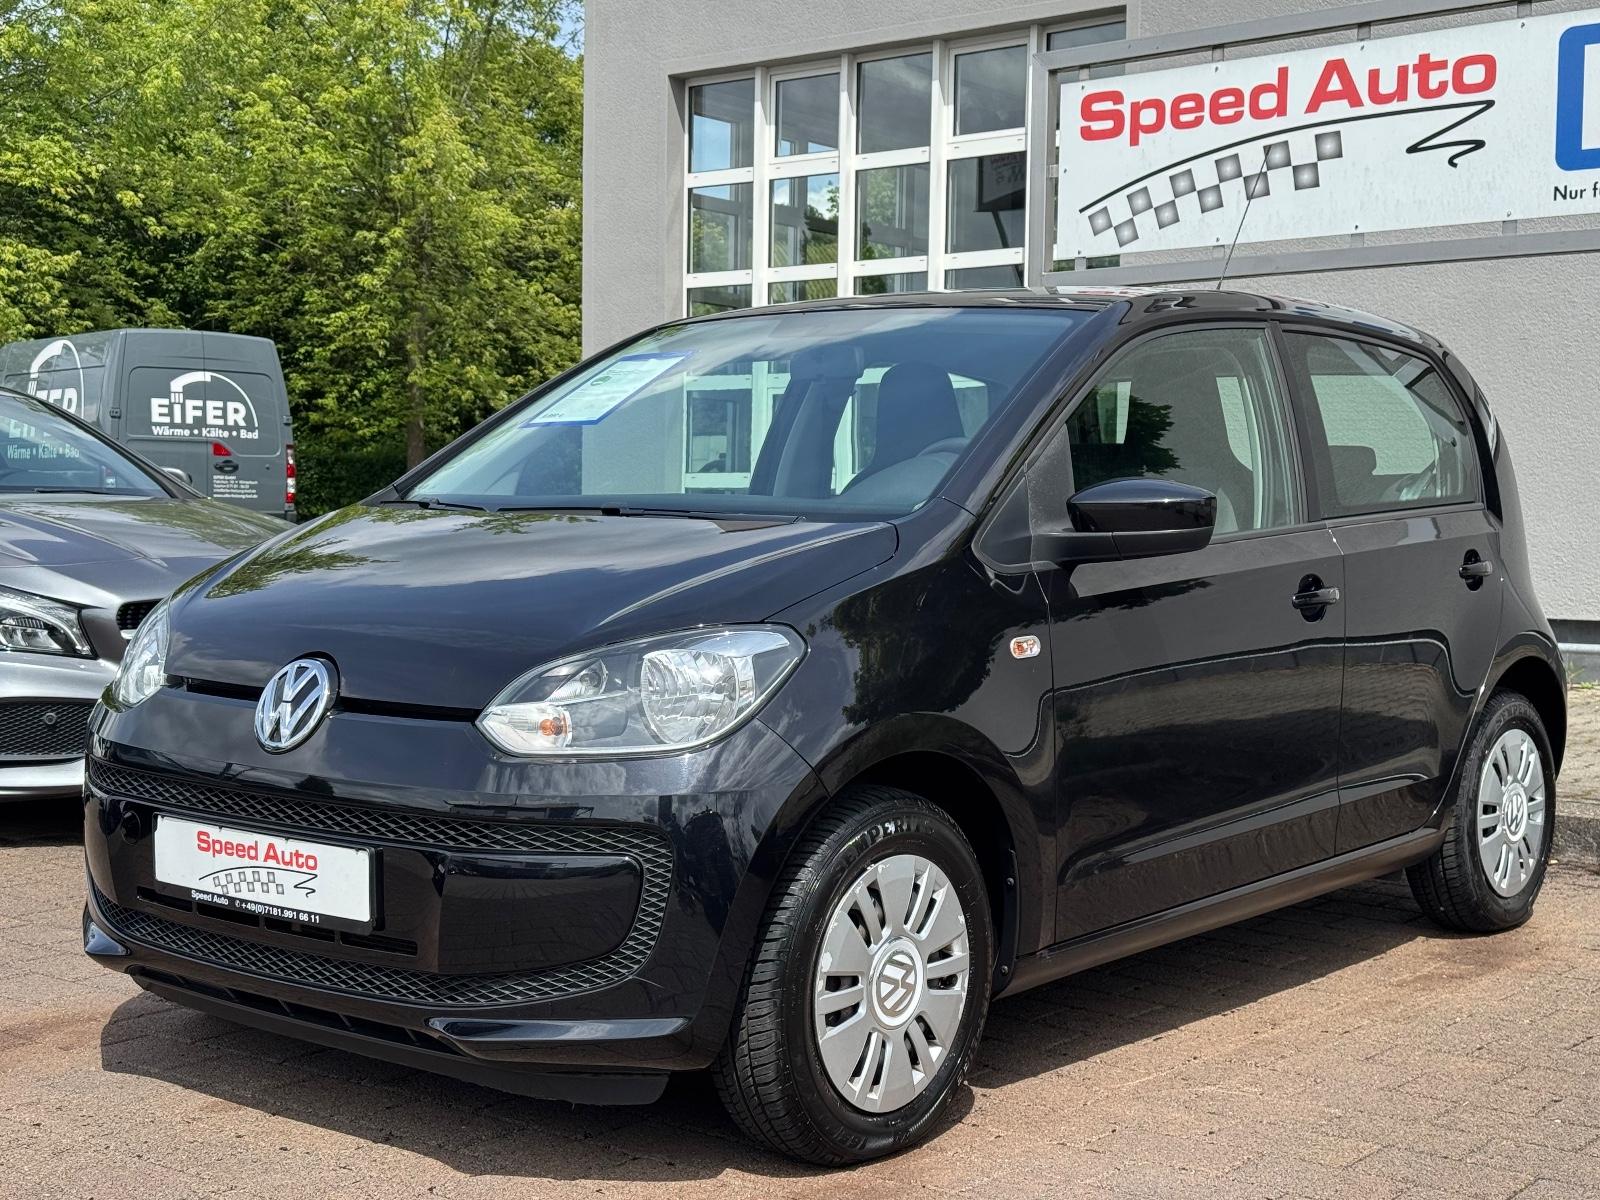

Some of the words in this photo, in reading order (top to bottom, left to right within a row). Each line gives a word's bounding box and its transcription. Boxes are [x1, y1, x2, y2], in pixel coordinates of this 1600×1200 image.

[1079, 66, 1289, 147] Speed
[1304, 53, 1498, 115] Auto
[1553, 185, 1587, 202] Nur
[151, 425, 191, 437] Wärme
[201, 427, 230, 439] Kälte
[239, 429, 259, 440] Bad
[196, 830, 259, 862] Speed
[263, 842, 318, 871] Auto
[191, 889, 212, 902] Speed
[213, 895, 229, 906] Auto
[299, 911, 309, 922] 66
[310, 914, 320, 924] 11
